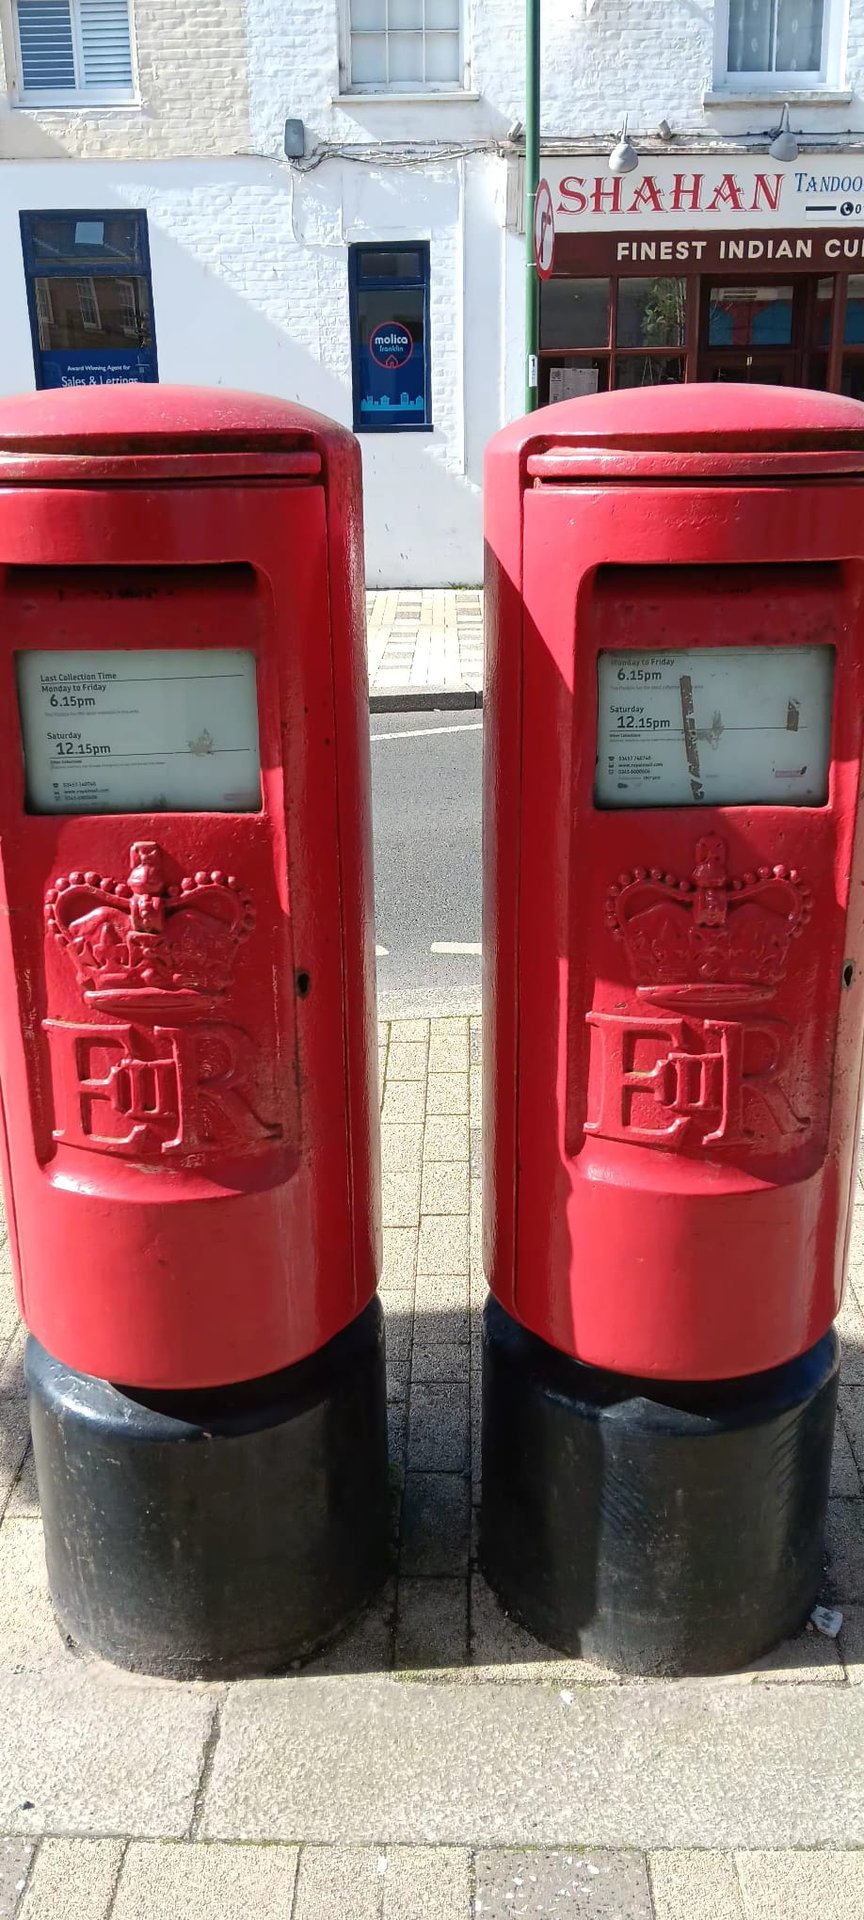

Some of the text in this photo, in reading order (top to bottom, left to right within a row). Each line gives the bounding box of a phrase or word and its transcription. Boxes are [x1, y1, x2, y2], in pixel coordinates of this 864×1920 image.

[795, 172, 864, 192] TANDOO
[557, 173, 786, 215] SHAHAN
[616, 241, 707, 261] FINEST
[719, 239, 812, 259] INDIAN
[374, 333, 408, 345] molica
[379, 345, 404, 353] franklin
[61, 375, 86, 387] Sales
[89, 376, 96, 386] &
[650, 658, 675, 666] Friday
[40, 672, 117, 682] Last Collection Time
[617, 668, 662, 682] 6.15pm
[41, 683, 107, 693] Monday to Friday
[50, 694, 96, 708] 6.15pm
[609, 705, 645, 713] Saturday
[617, 715, 670, 730] 12.15pm
[46, 731, 82, 740] Saturday
[56, 741, 111, 756] 12.15pm
